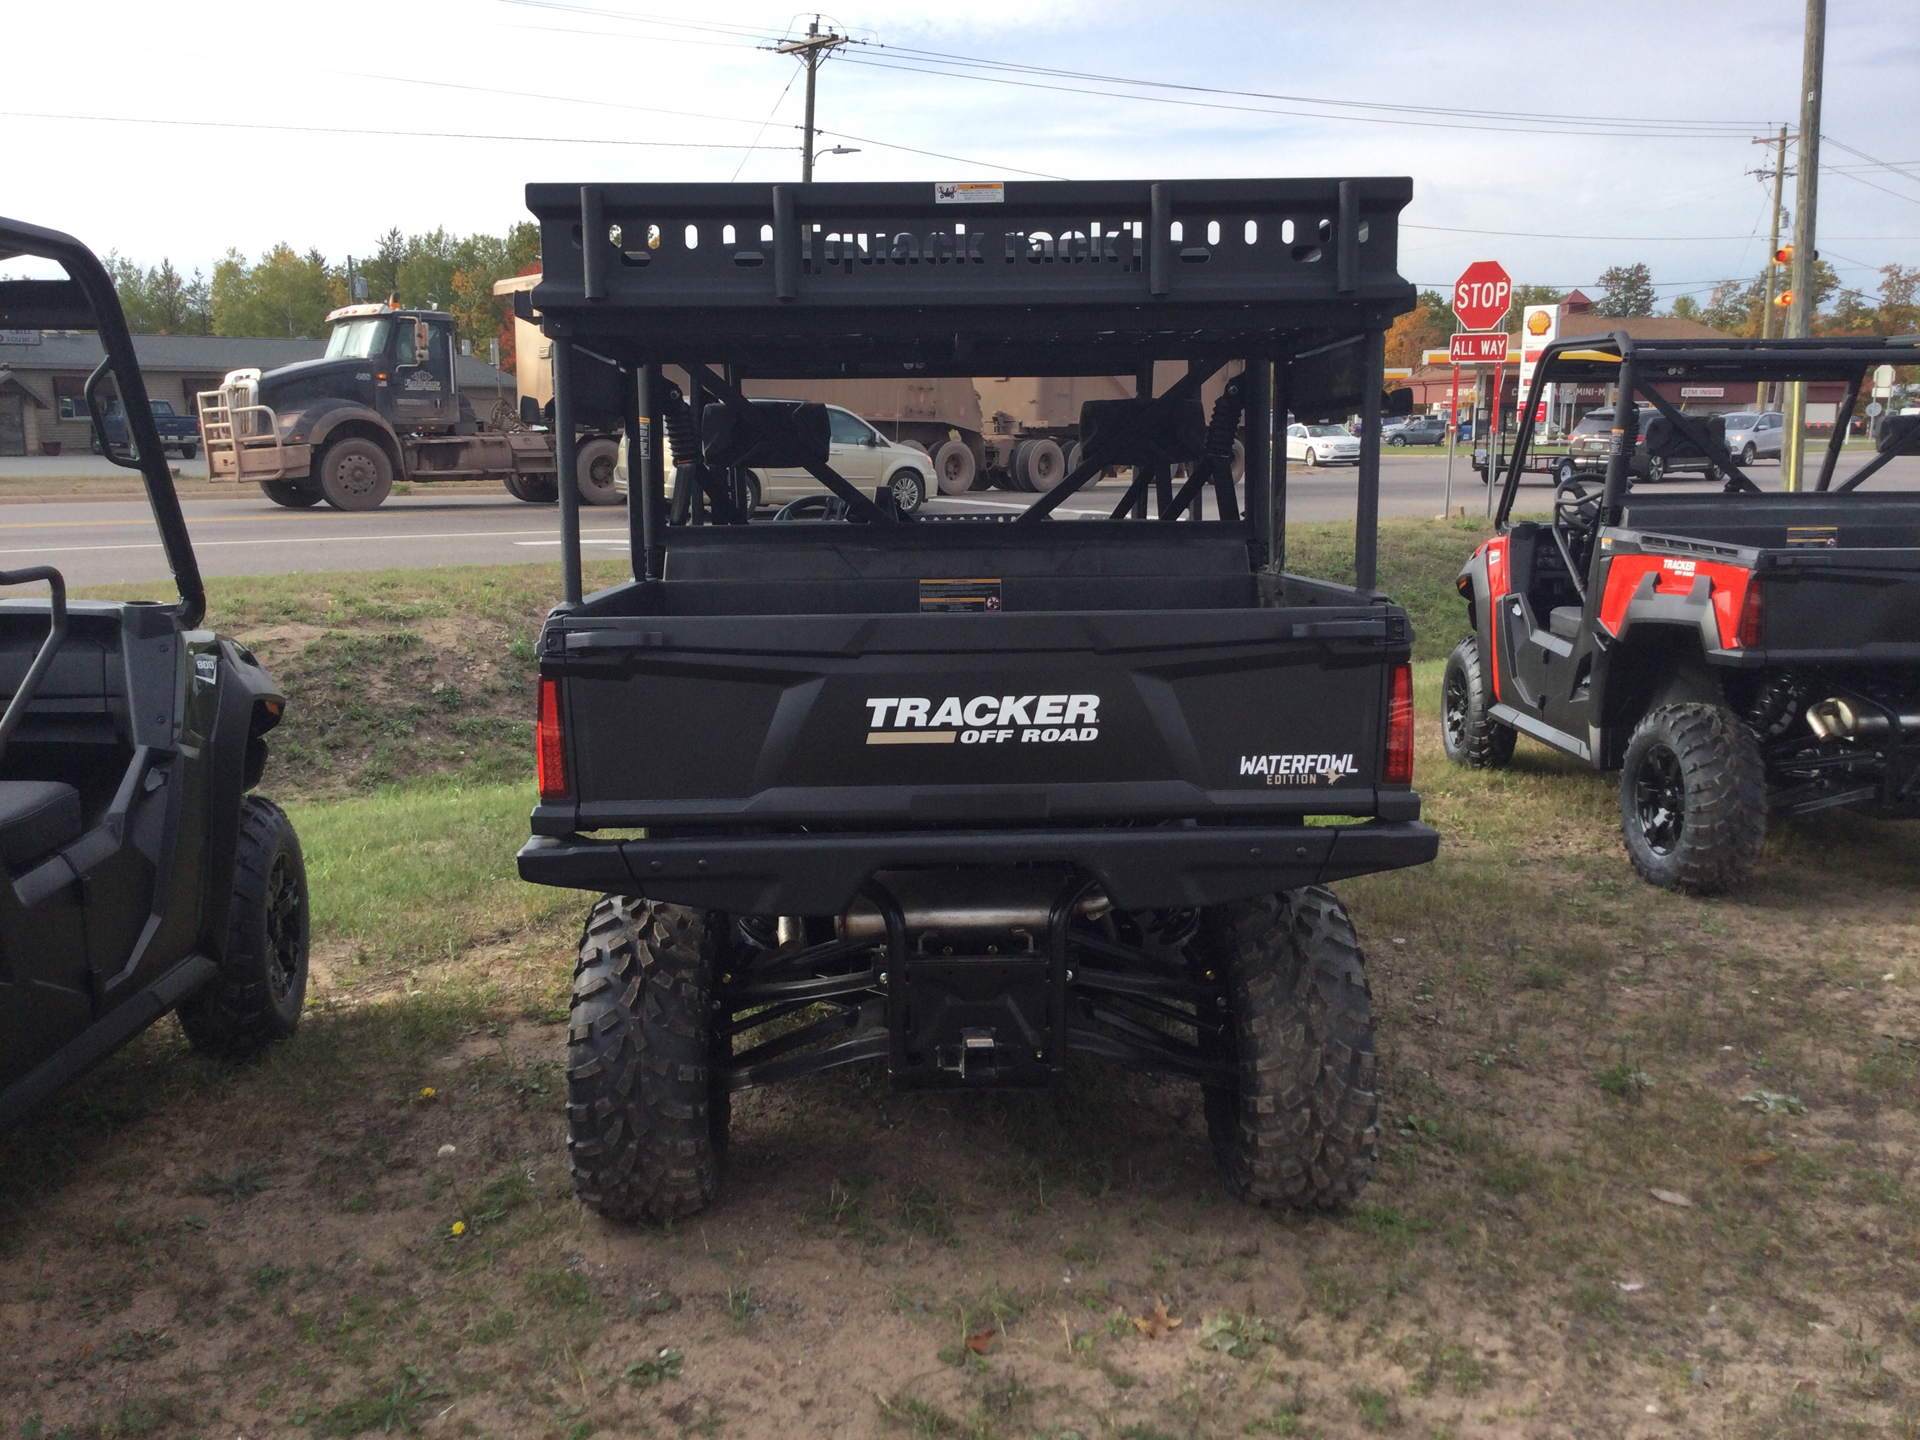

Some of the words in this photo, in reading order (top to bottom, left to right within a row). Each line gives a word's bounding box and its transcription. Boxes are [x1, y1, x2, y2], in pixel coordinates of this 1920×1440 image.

[1457, 282, 1508, 309] STOP
[1453, 341, 1476, 356] ALL
[1481, 340, 1506, 356] WAY
[1663, 559, 1696, 571] TRACKER
[196, 660, 214, 669] 800
[866, 694, 1100, 728] TRACKER
[960, 729, 1014, 744] OFF
[1021, 727, 1099, 743] ROAD
[1240, 754, 1358, 775] WATERFOWL
[1266, 774, 1317, 785] EDITION
